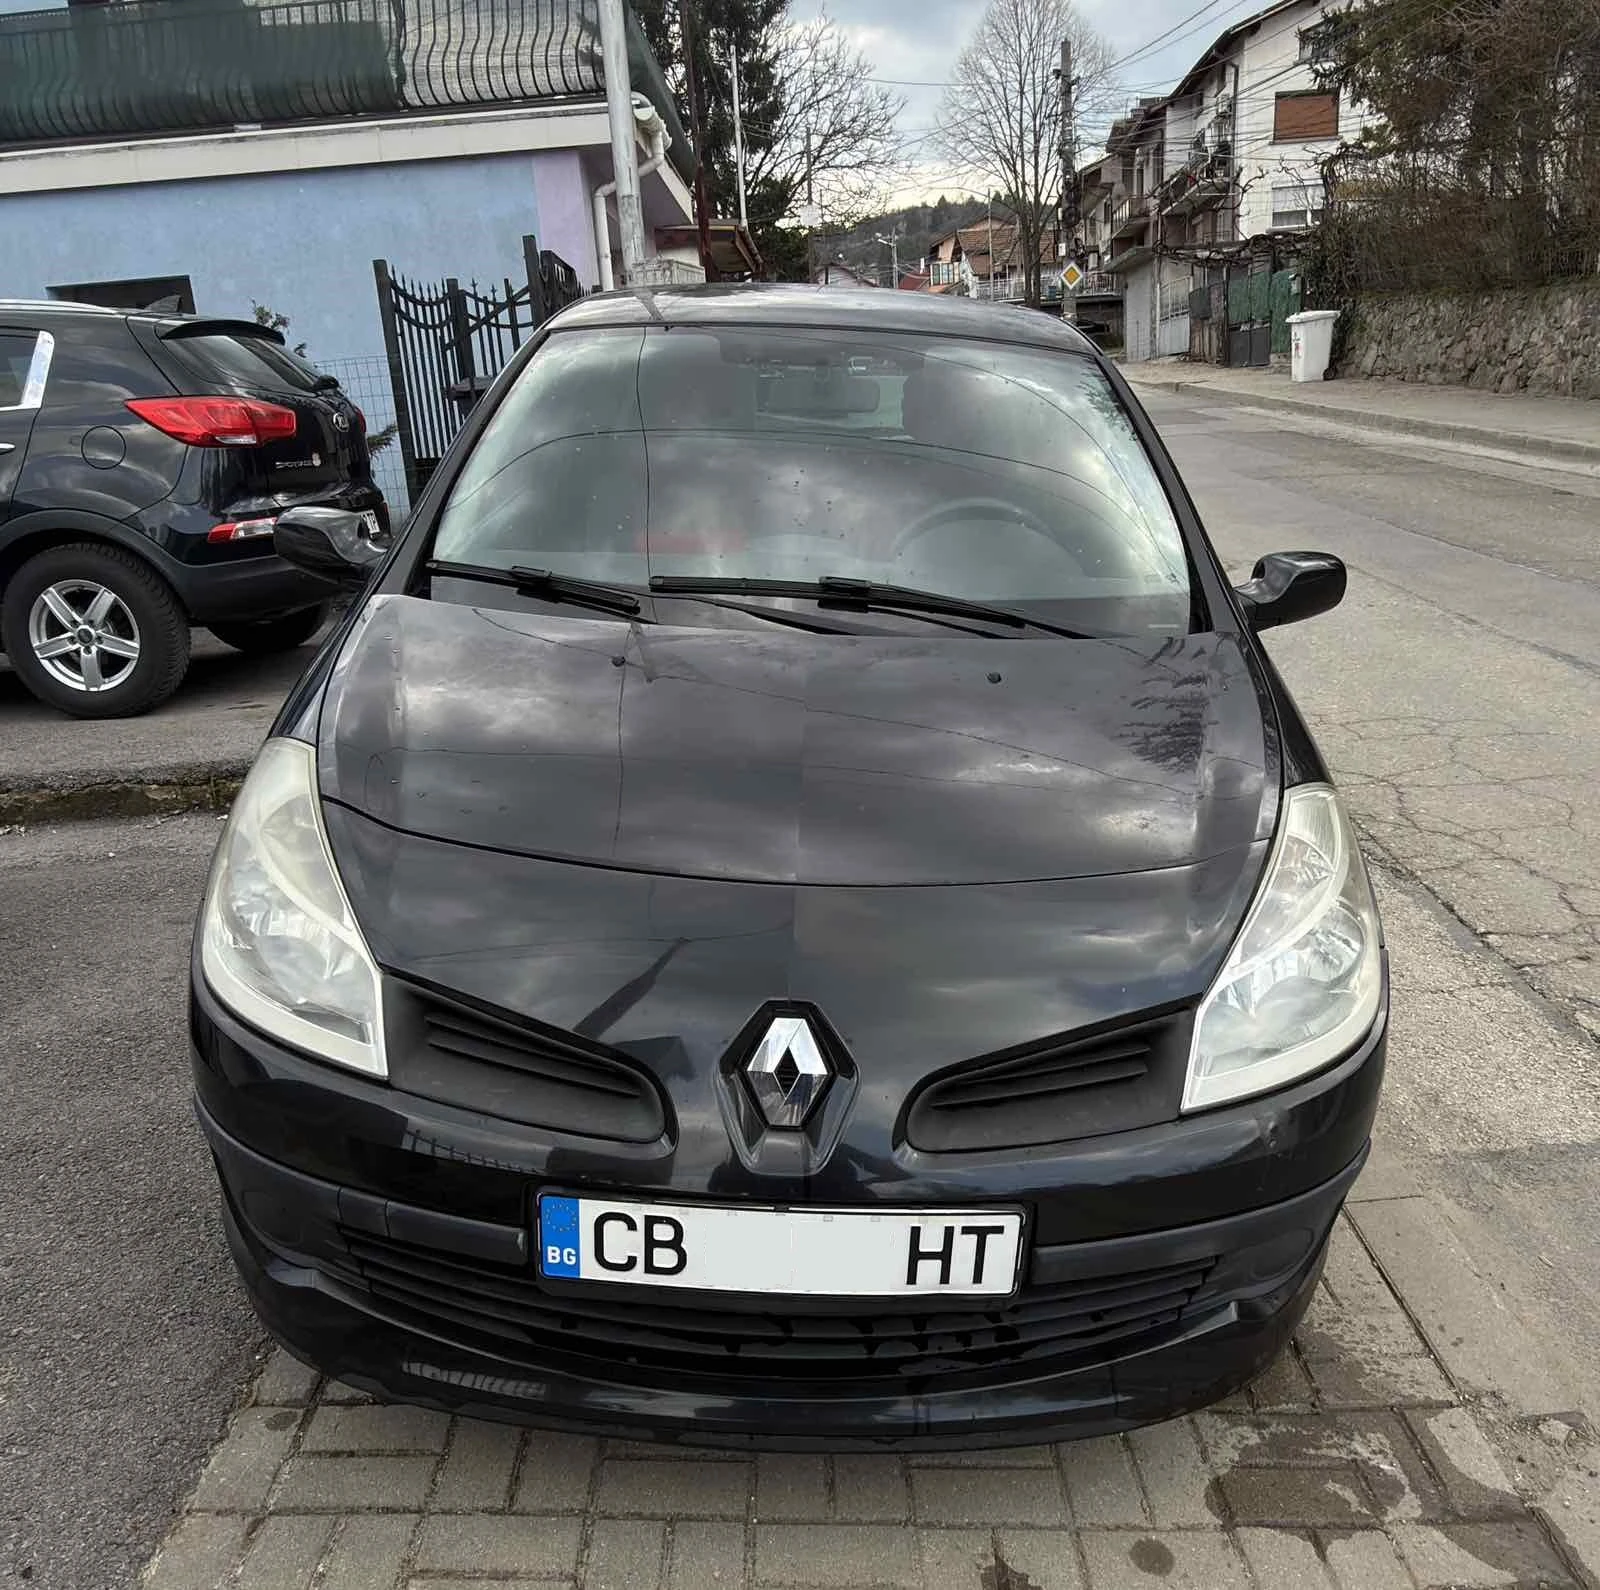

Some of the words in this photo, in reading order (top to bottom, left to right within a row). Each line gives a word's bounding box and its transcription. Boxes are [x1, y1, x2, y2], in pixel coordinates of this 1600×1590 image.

[547, 1246, 576, 1265] BG
[594, 1212, 687, 1275] CB
[907, 1226, 1004, 1285] HT
